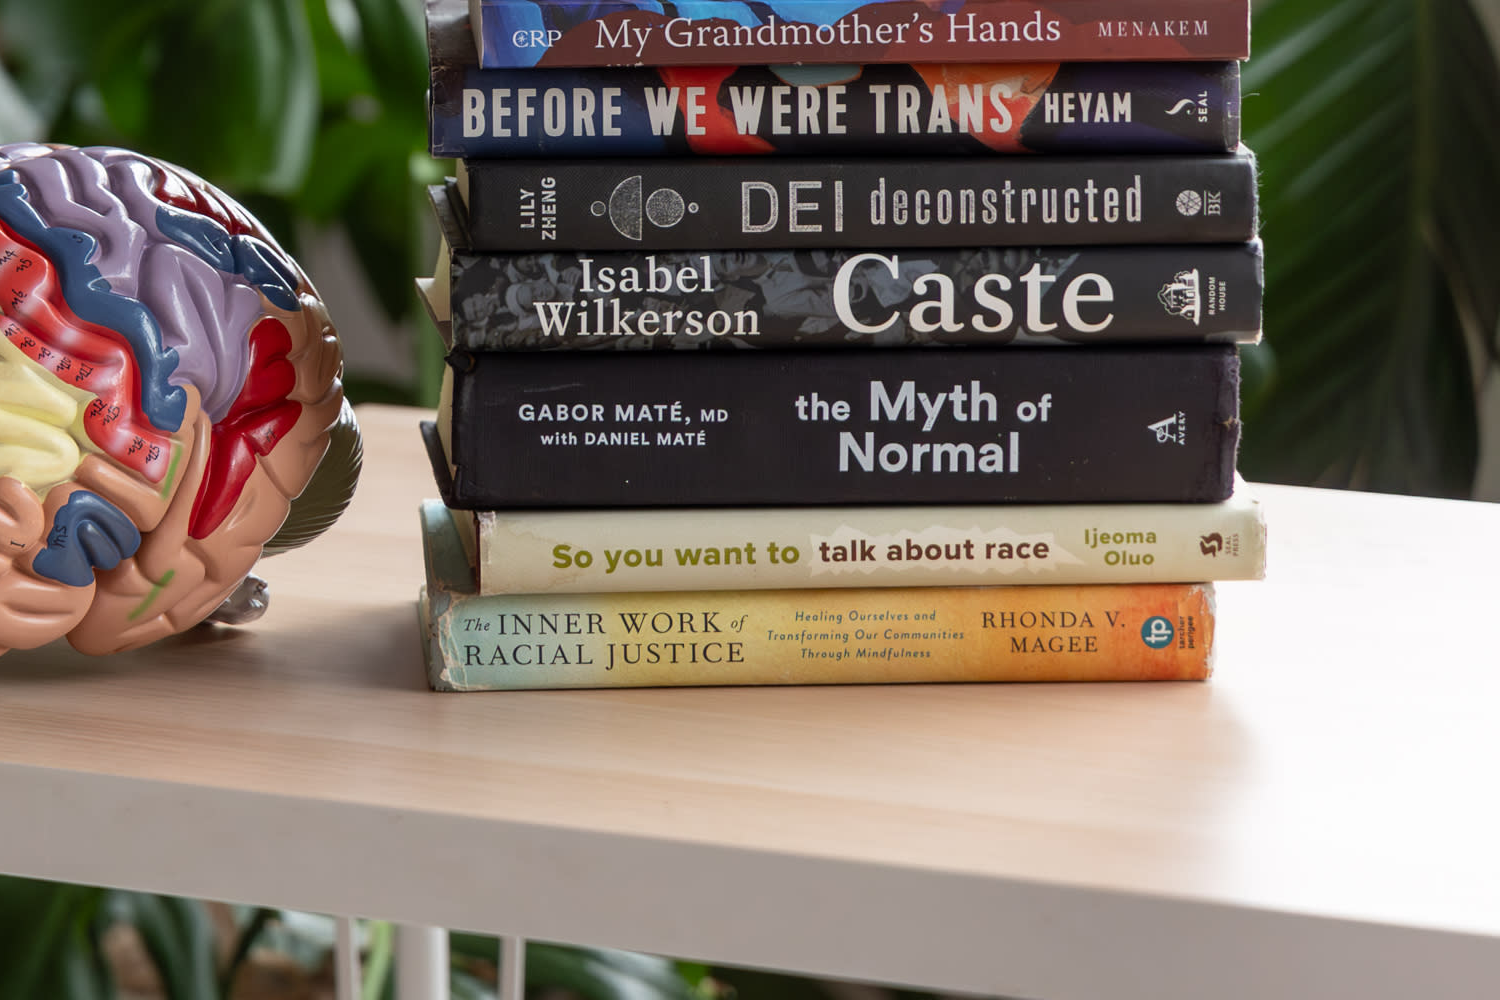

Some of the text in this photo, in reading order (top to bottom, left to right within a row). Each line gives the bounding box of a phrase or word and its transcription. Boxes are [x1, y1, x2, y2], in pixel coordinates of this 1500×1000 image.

[595, 11, 1060, 57] My Grandmother's Hands
[1098, 20, 1208, 37] MENAKEM
[462, 84, 1013, 138] BEFORE WE WERE TRANS
[1044, 92, 1132, 124] HEYAM
[1198, 90, 1208, 122] SEAL
[520, 188, 535, 229] LILY
[542, 176, 556, 240] ZHENG
[741, 175, 1142, 233] DEI deconstructed
[1208, 190, 1221, 216] BK
[579, 256, 714, 293] Isabel
[834, 254, 1114, 334] Caste
[533, 298, 760, 336] Wilkerson
[519, 401, 728, 424] GABOR MATÉ, MD
[795, 381, 1051, 432] the Myth of
[540, 430, 706, 446] with DANIEL MATÉ
[839, 432, 1019, 472] Normal
[1085, 528, 1157, 549] Ijeoma
[552, 538, 1050, 574] So you want to talk about race
[1104, 550, 1154, 566] Oluo
[464, 612, 748, 636] The INNER WORK of
[795, 610, 936, 624] Healing Ourselves and
[982, 610, 1126, 629] RHONDA V.
[1146, 618, 1168, 644] tp
[767, 628, 965, 644] Transforming Our Communities
[1011, 636, 1098, 653] MAGEE
[465, 642, 745, 670] RACIAL JUSTICE
[800, 646, 931, 660] Through Mindfulness
